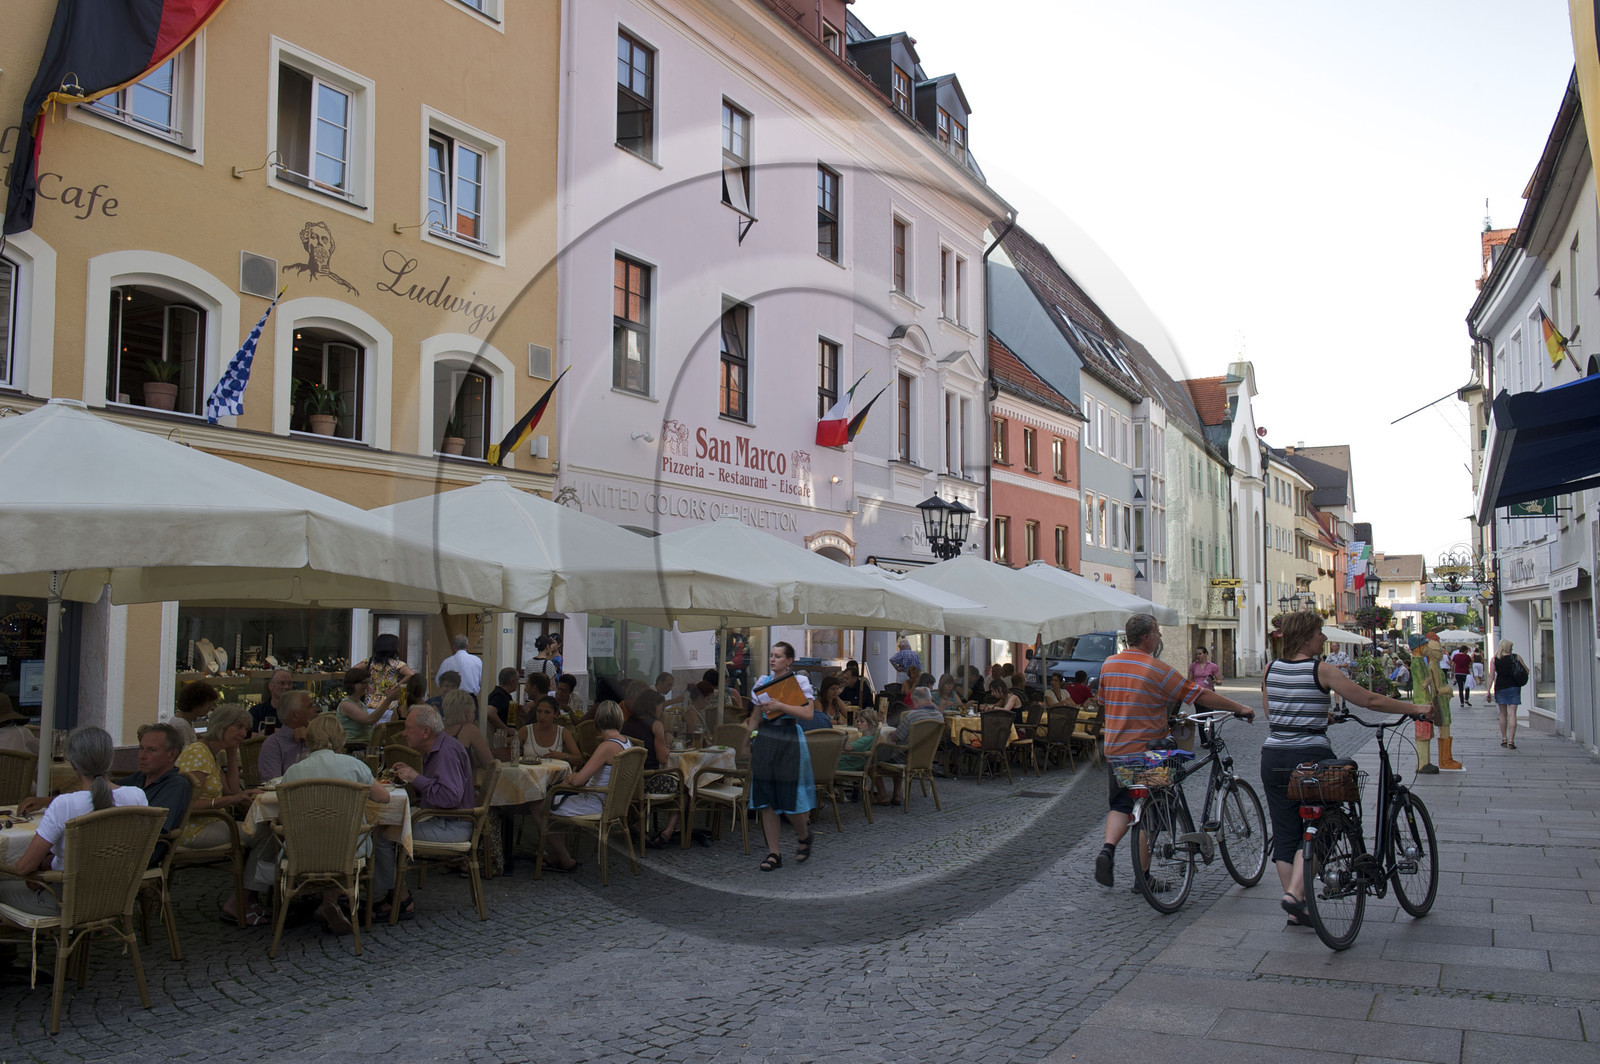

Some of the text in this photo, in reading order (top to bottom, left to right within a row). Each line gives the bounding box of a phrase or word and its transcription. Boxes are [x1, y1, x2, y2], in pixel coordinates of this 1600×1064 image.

[36, 172, 119, 220] Cafe
[376, 249, 498, 334] Ludwigs
[695, 426, 787, 476] San Marco
[574, 480, 641, 511] UNITED
[645, 491, 706, 521] COLORS
[710, 502, 728, 522] OF
[662, 456, 705, 479] Pizzeria
[718, 467, 768, 490] Restaurant
[779, 479, 811, 498] Eiscafe
